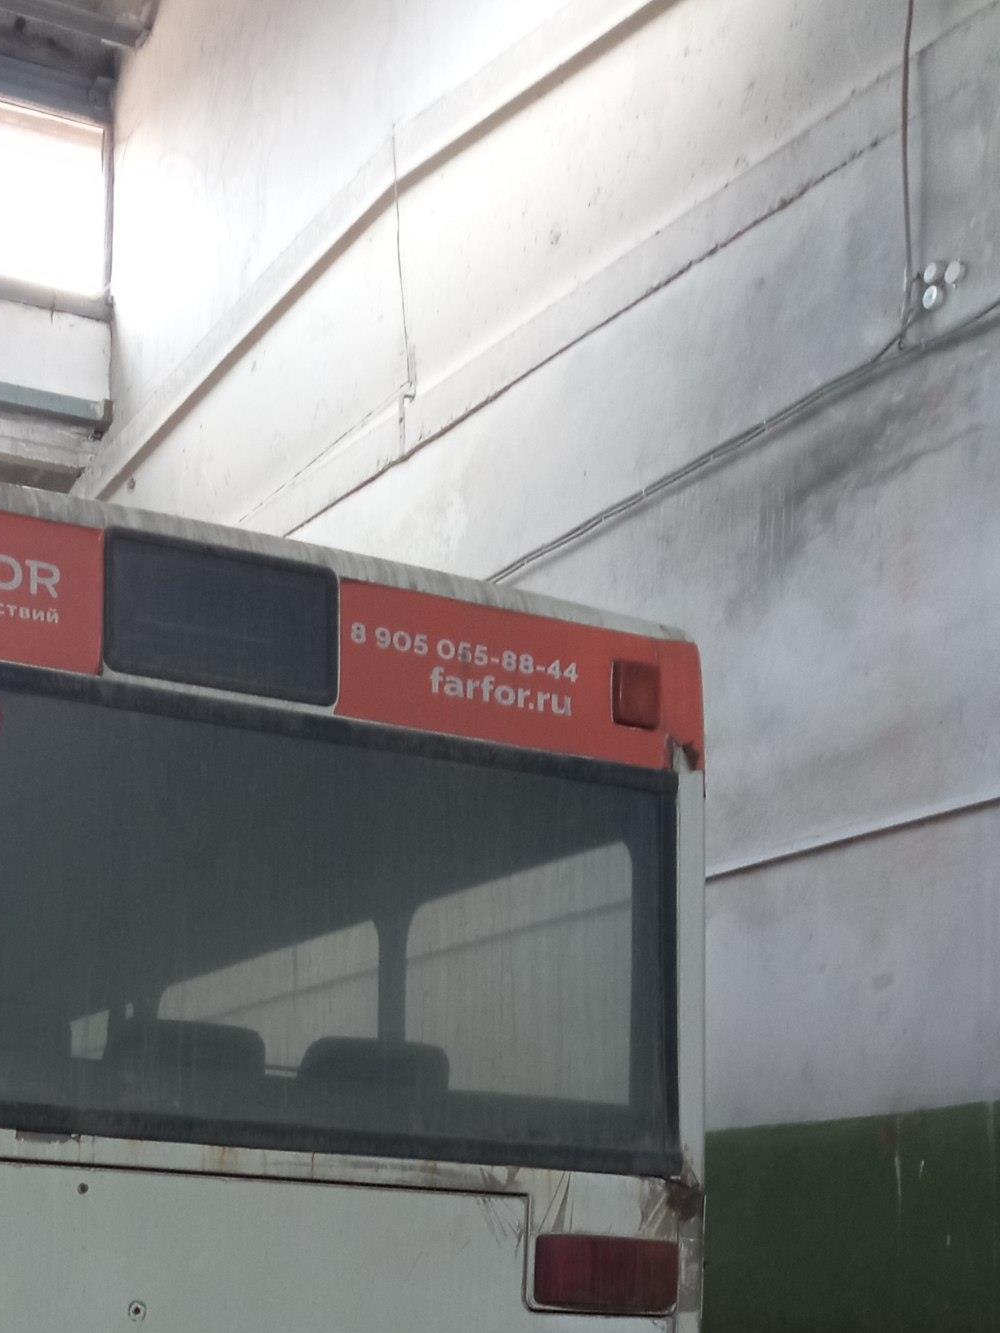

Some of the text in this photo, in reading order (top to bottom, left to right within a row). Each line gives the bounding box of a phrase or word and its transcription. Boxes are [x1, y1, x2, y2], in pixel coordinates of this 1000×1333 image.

[350, 622, 579, 683] 8 905 055-88-44
[428, 666, 573, 718] farfor.ru
